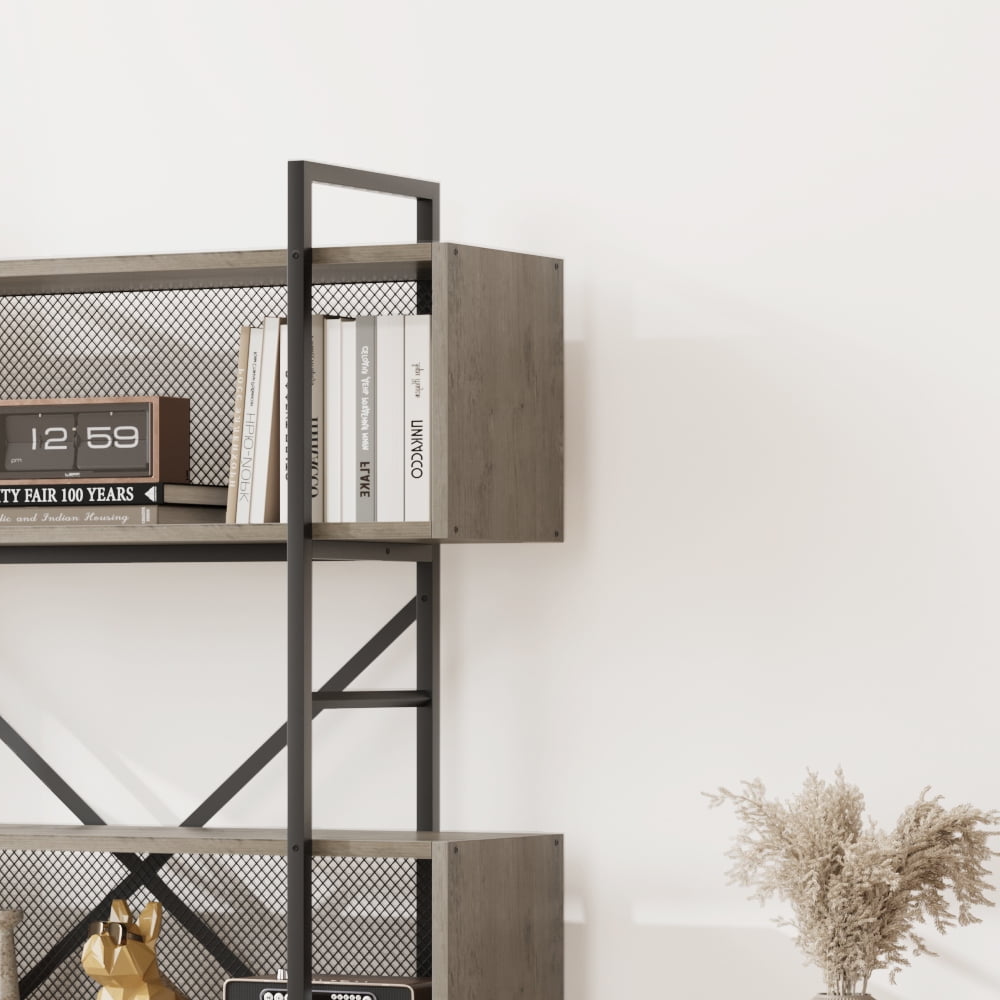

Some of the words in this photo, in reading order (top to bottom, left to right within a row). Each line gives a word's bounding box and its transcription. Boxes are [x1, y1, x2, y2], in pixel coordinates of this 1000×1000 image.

[24, 487, 57, 503] FAIR
[61, 487, 84, 503] 100
[86, 486, 134, 502] YEARS
[16, 512, 37, 523] and
[41, 511, 79, 523] Indian
[83, 511, 129, 525] Housing
